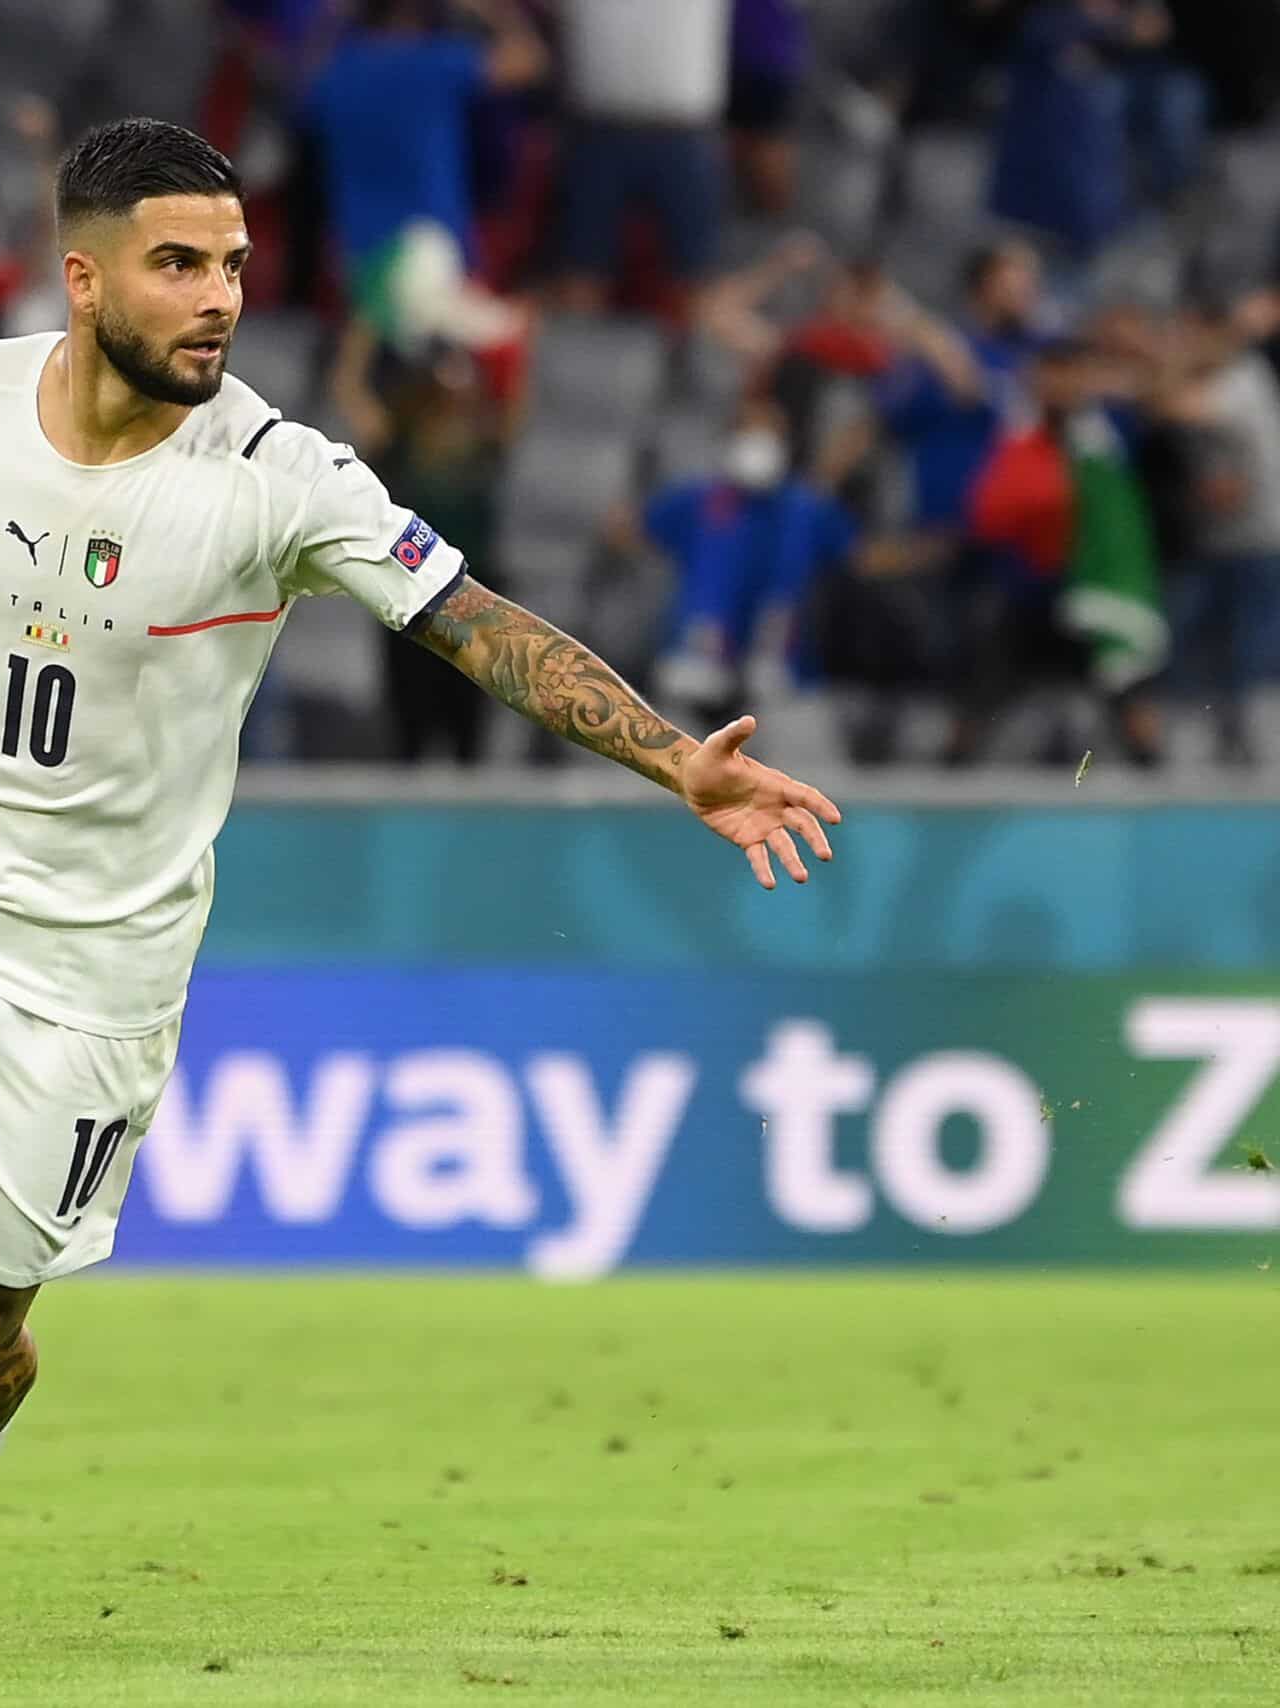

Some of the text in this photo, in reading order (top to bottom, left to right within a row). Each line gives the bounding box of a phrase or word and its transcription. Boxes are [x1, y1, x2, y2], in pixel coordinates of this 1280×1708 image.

[1, 653, 76, 768] 10
[56, 1118, 128, 1217] 10
[133, 1048, 696, 1283] way
[737, 1016, 1052, 1234] to
